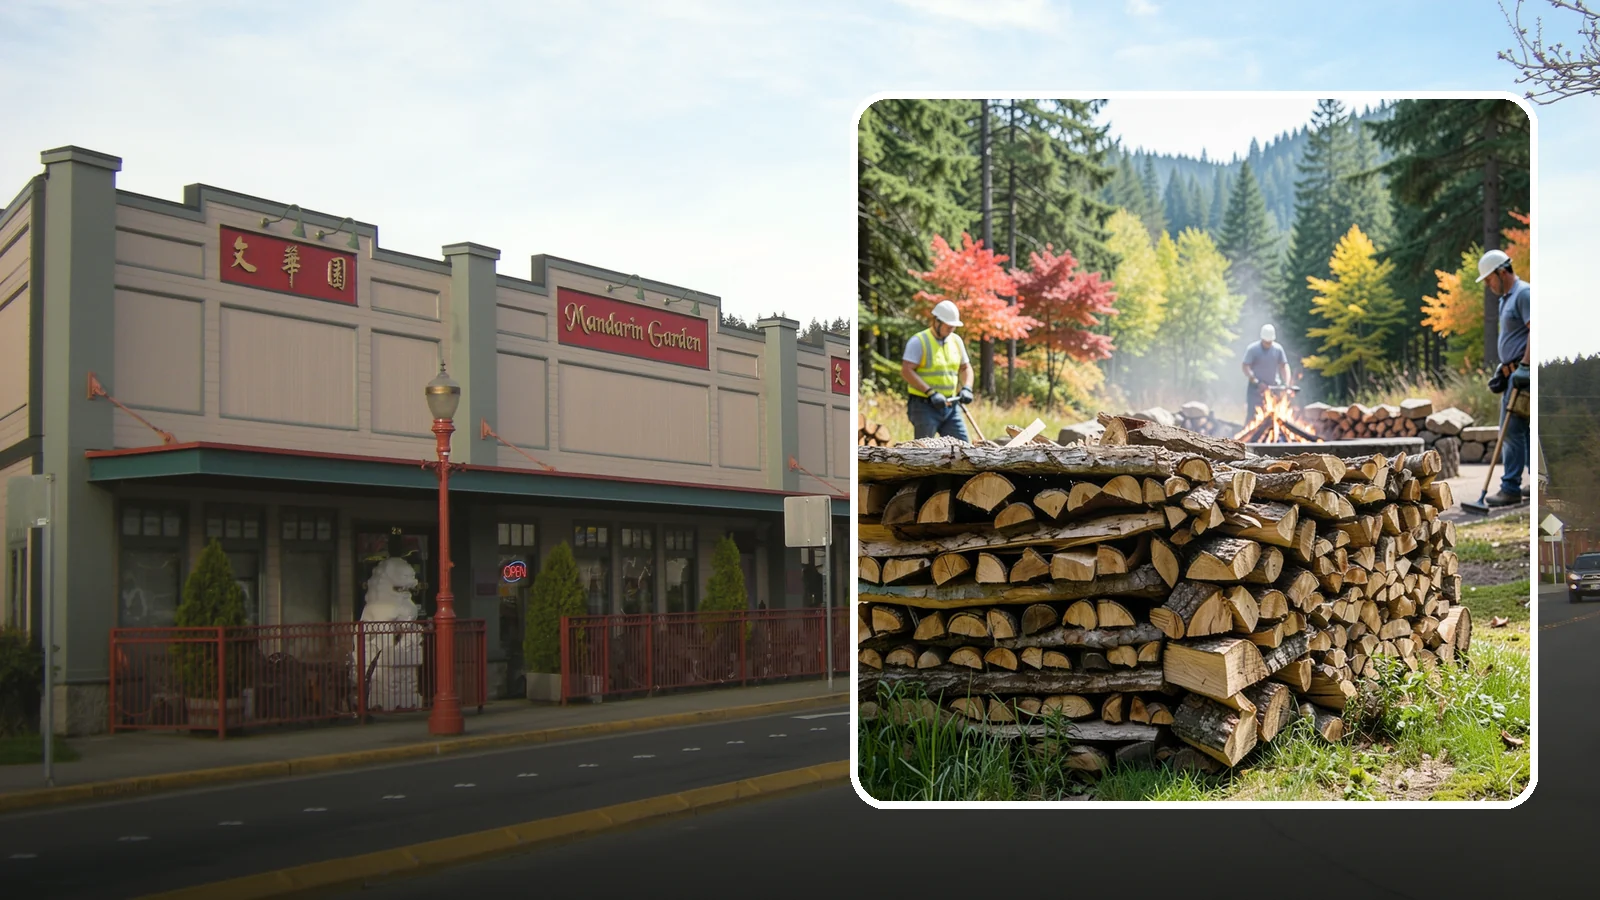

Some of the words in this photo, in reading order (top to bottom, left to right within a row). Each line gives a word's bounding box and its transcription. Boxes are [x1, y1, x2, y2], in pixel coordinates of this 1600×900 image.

[231, 236, 346, 290] 文華園
[564, 302, 644, 341] Mandarin
[648, 320, 701, 352] Garden
[835, 363, 846, 386] 文
[503, 565, 527, 578] OPEN
